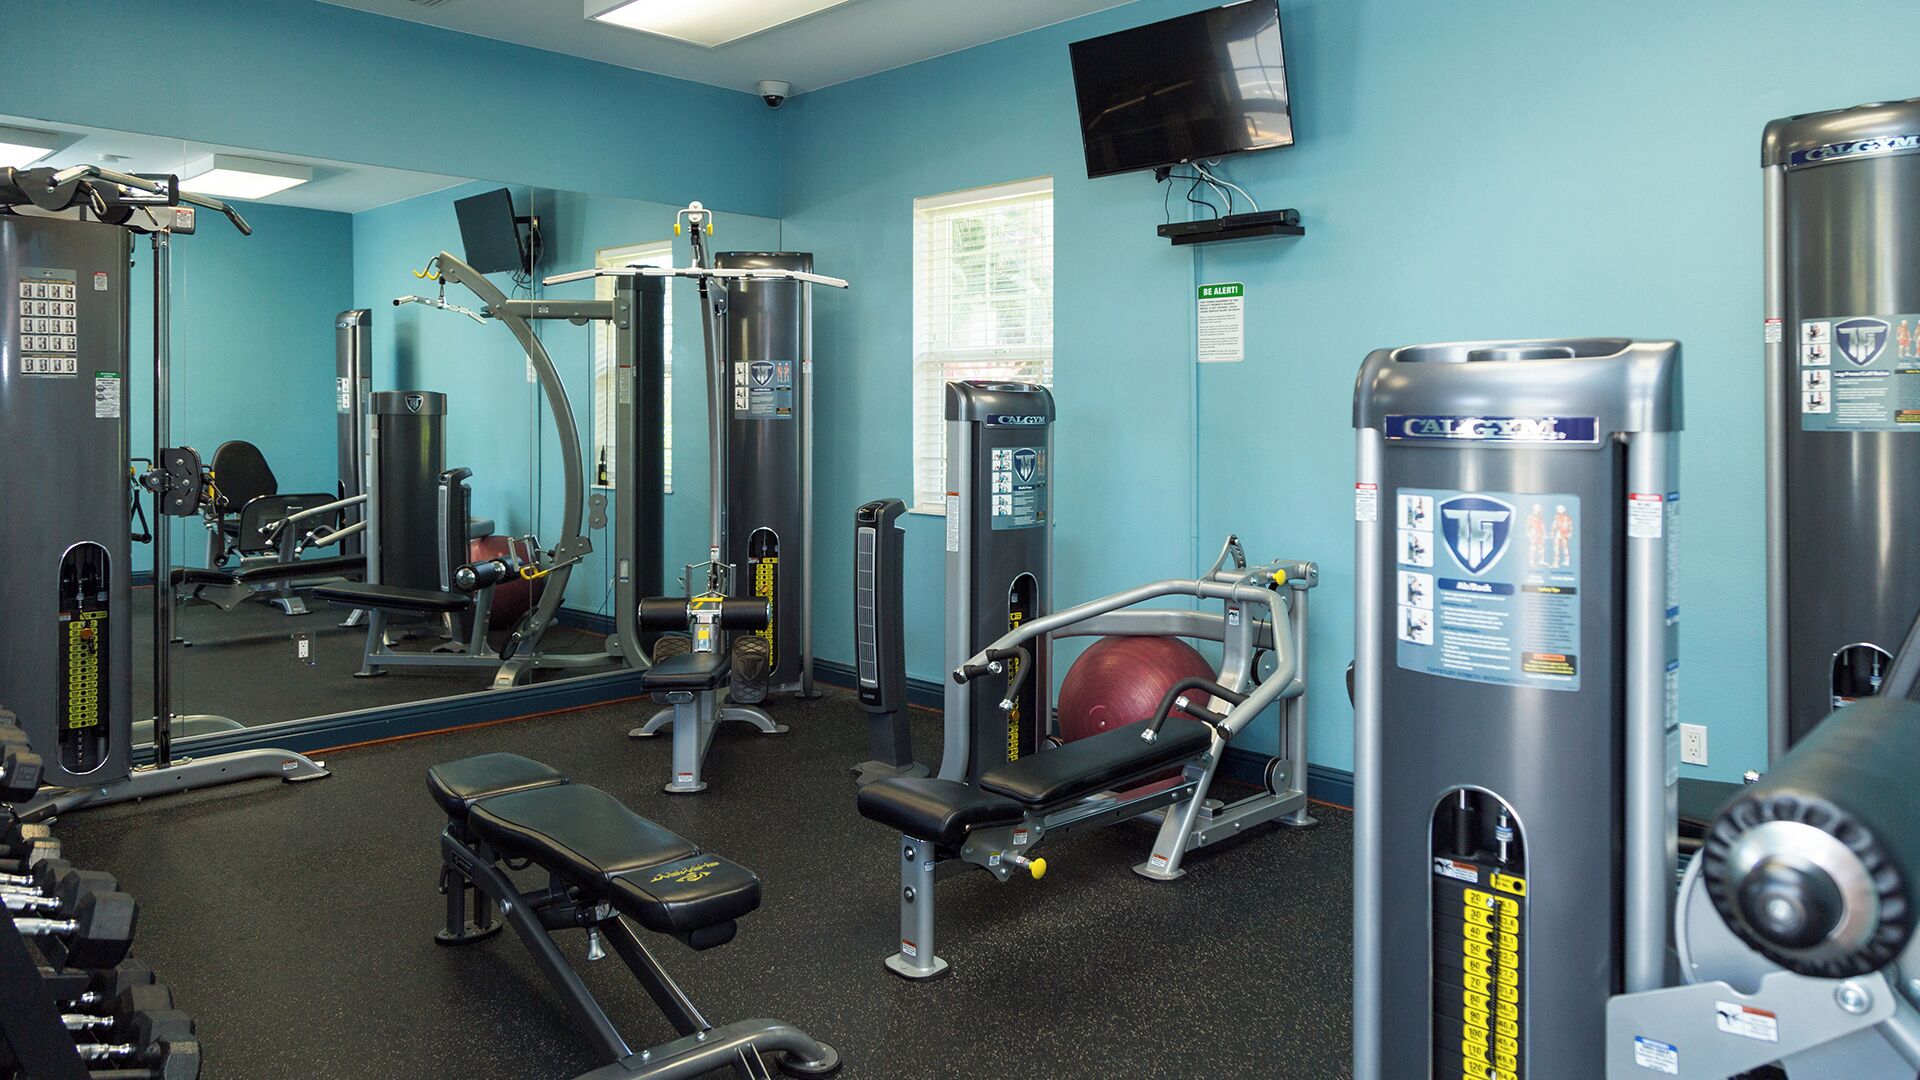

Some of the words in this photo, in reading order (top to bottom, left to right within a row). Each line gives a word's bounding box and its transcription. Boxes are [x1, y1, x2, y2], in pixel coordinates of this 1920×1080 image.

[1203, 288, 1212, 296] BE
[1214, 286, 1238, 295] ALERT!
[1470, 892, 1481, 901] 20
[1470, 909, 1481, 918] 30
[1470, 927, 1481, 935] 40
[1470, 943, 1481, 952] 50
[1470, 960, 1481, 969] 60
[1470, 977, 1481, 986] 70
[1470, 994, 1481, 1003] 80
[1470, 1011, 1481, 1020] 90
[1468, 1027, 1483, 1037] 100
[1467, 1044, 1482, 1054] 110
[1468, 1061, 1483, 1072] 120
